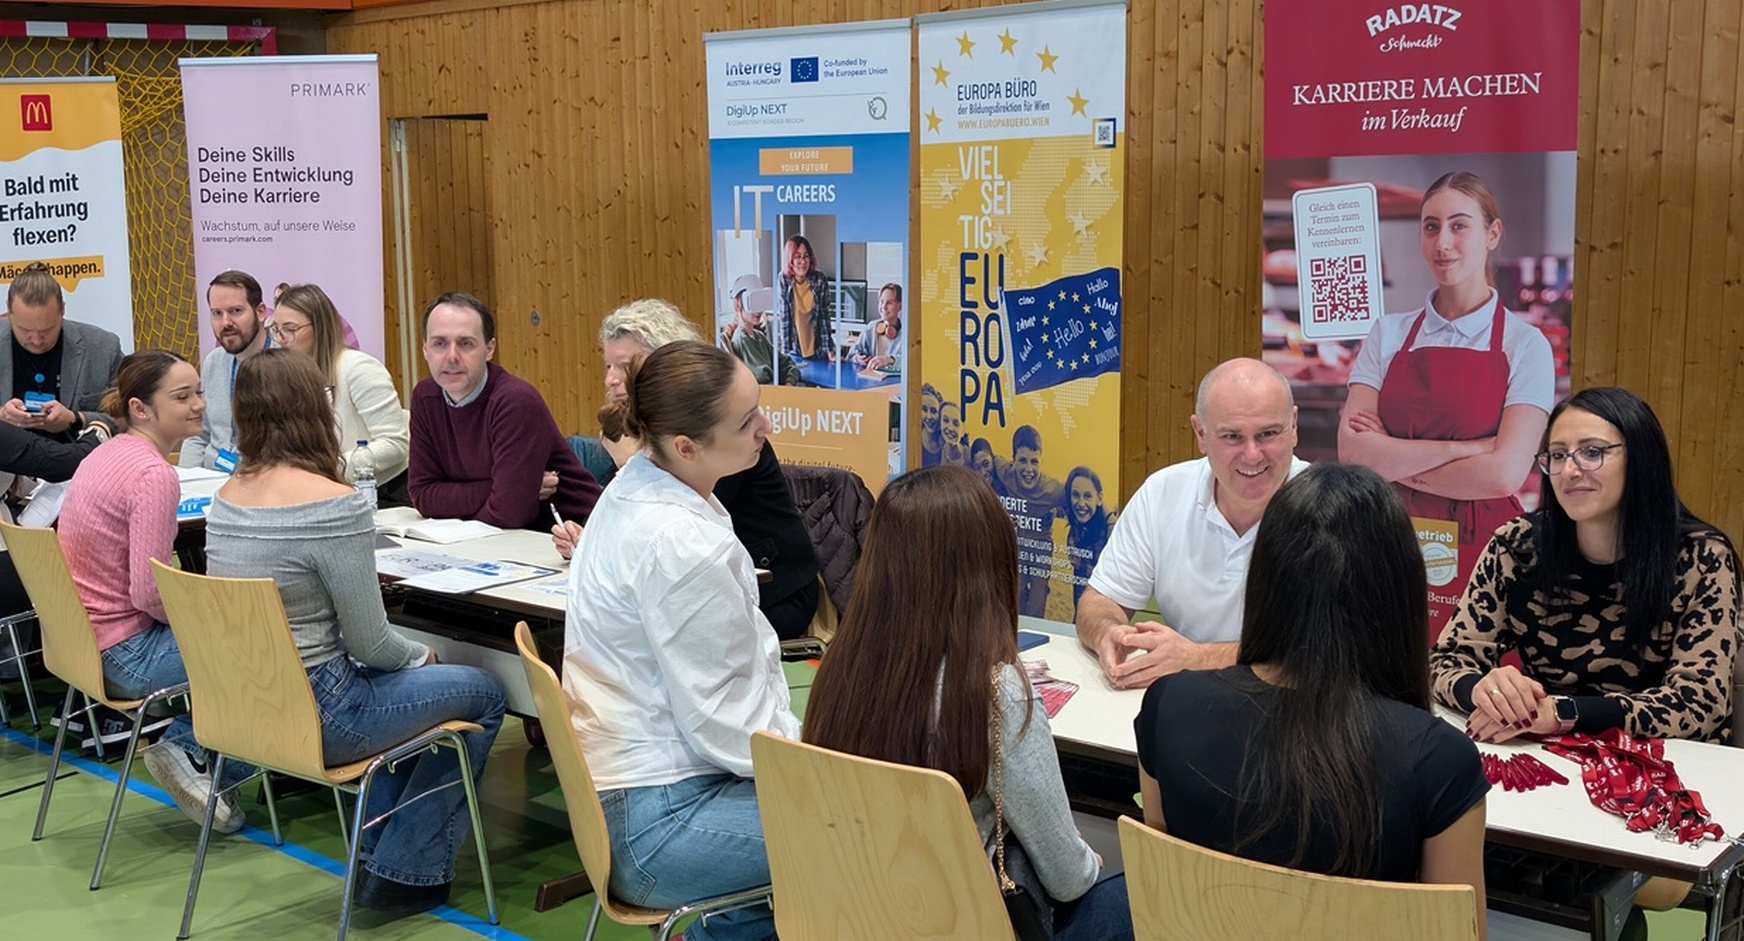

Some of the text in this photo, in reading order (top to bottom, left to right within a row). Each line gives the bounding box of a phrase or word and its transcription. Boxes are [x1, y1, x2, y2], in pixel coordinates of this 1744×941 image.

[1365, 3, 1462, 37] RADATZ
[725, 62, 781, 76] Interreg
[824, 58, 867, 68] Co-funded by
[824, 67, 888, 79] the European Union
[958, 77, 1038, 101] EUROPA BÜRO
[1293, 72, 1543, 105] KARRIERE MACHEN
[727, 104, 787, 119] DigiUp NEXT
[958, 101, 1050, 116] der Bildungsdirektion für Wien
[958, 117, 1050, 130] WWW.EUROPABUERO.WIEN
[1361, 106, 1467, 132] im Verkauf
[198, 147, 295, 162] Deine Skills
[789, 150, 820, 160] EXPLORE
[958, 145, 1004, 181] VIEL
[781, 163, 829, 172] YOUR FUTURE
[4, 172, 79, 197] Bald mit
[199, 167, 354, 186] Deine Entwicklung
[200, 188, 321, 204] Deine Karriere
[981, 180, 1012, 215] SEI
[0, 199, 89, 223] Erfahrung
[734, 184, 836, 239] IT CAREERS
[1309, 200, 1360, 213] Gleich einen
[201, 219, 356, 233] Wachstum, auf unsere Weise
[1310, 213, 1360, 225] Termin zum
[13, 224, 77, 247] flexen?
[959, 215, 994, 250] TIG
[1307, 225, 1365, 237] Kennenlernen
[201, 236, 274, 245] careers.primark.com
[1312, 236, 1362, 248] vereinbaren:
[960, 252, 1005, 311] EU
[960, 311, 1005, 369] RO
[1053, 318, 1085, 349] Hello
[960, 368, 1006, 428] PA
[816, 409, 864, 435] NEXT
[1416, 530, 1453, 543] etrieb
